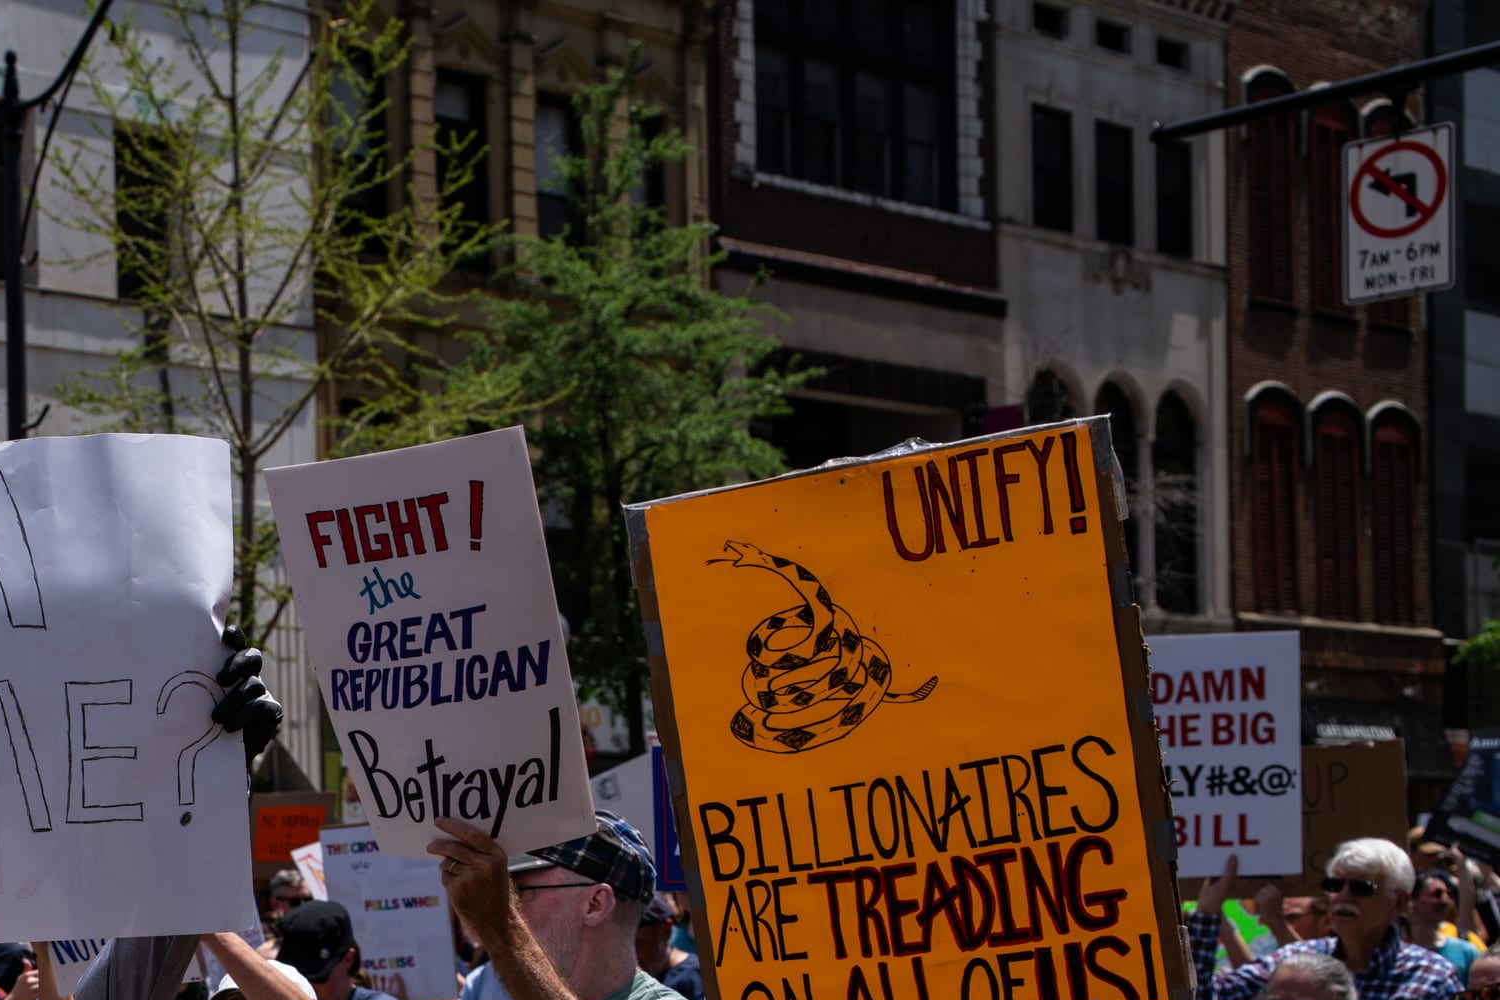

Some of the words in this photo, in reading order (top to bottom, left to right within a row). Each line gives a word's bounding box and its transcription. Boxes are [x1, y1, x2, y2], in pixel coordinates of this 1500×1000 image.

[1358, 248, 1390, 268] 7AM
[1406, 241, 1441, 262] 6PM
[1365, 273, 1397, 290] MON
[1410, 264, 1435, 283] FRI
[882, 432, 1088, 562] UNIFY!
[359, 567, 421, 615] the
[347, 604, 487, 664] GREAT
[331, 639, 551, 712] REPUBLICAN
[1151, 666, 1266, 705] DAMN
[1155, 715, 1202, 748] HE
[1211, 712, 1276, 746] BIG
[347, 707, 562, 839] Betrayal
[699, 735, 1119, 882] BILLIONAIRES
[716, 876, 807, 967] ARE
[808, 836, 1127, 961] TREADING
